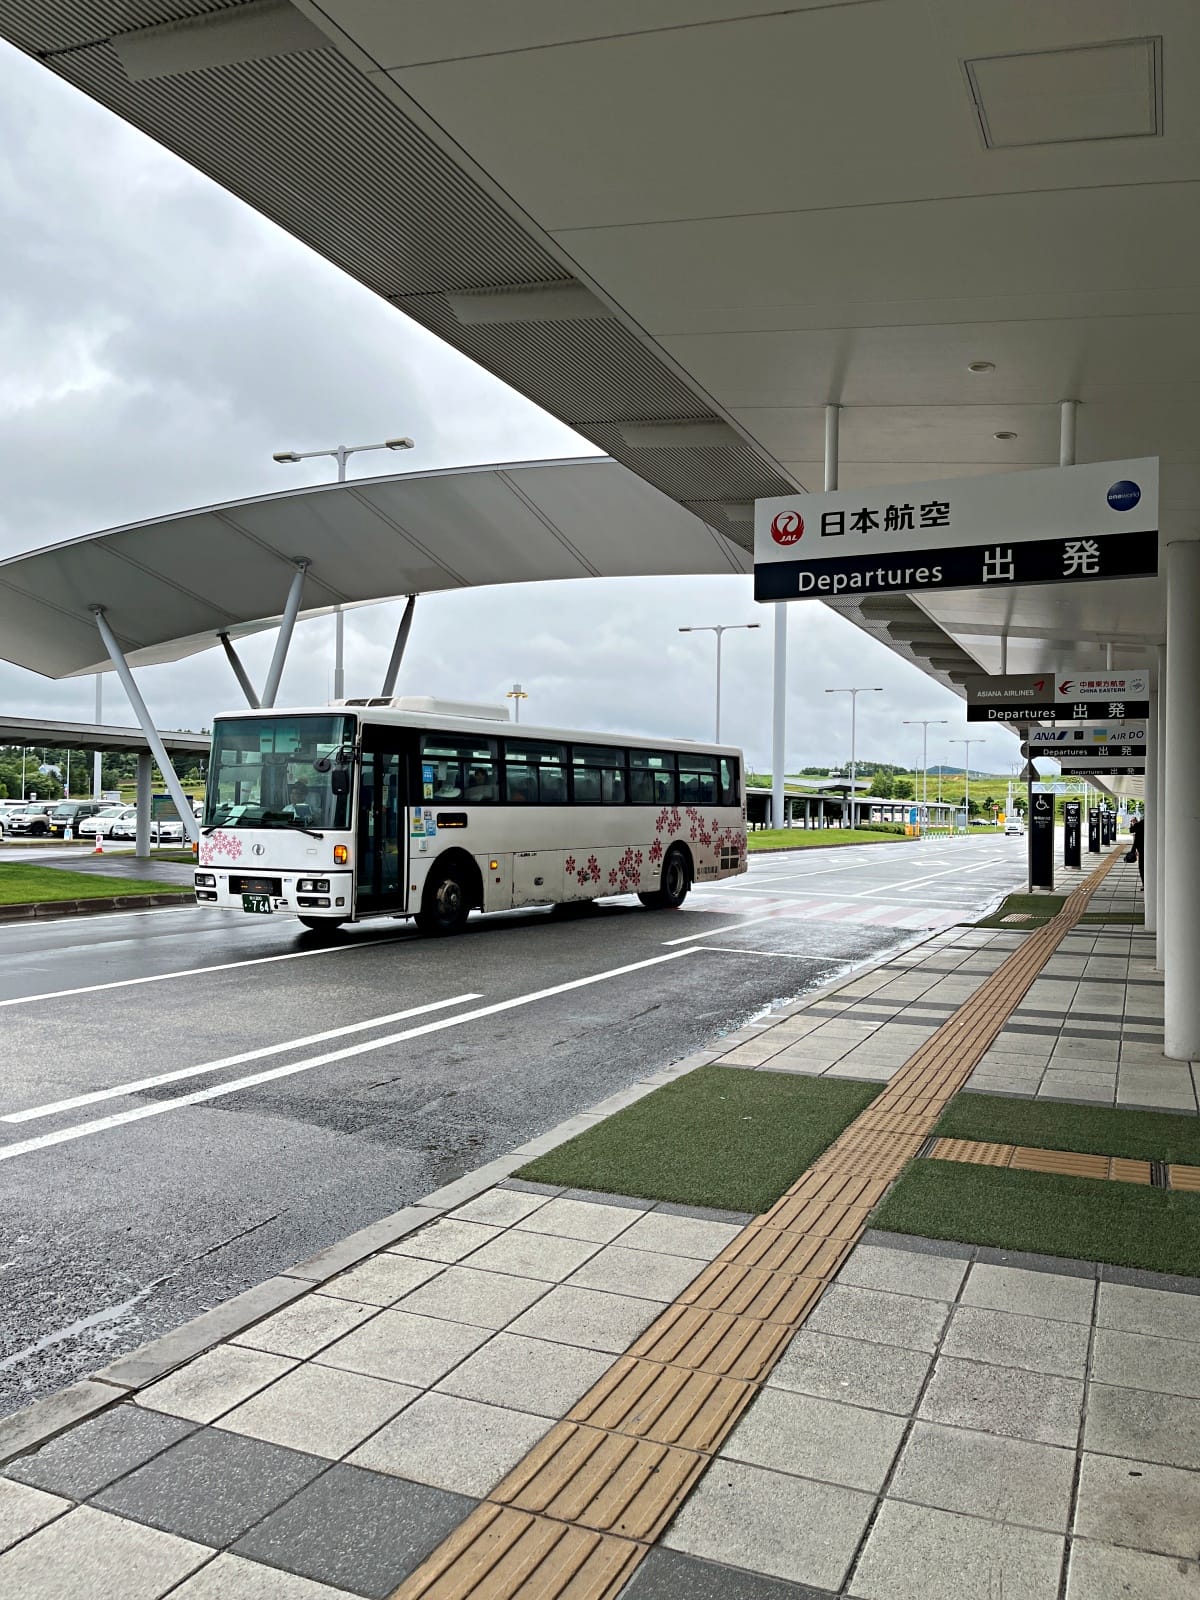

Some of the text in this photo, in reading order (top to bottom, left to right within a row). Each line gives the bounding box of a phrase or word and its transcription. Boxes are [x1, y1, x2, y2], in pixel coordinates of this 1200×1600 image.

[820, 500, 951, 537] 日本航空
[779, 534, 798, 543] JAL
[798, 565, 943, 593] Departures
[977, 689, 1035, 698] ASIANA AIRLINES
[988, 708, 1056, 721] Departures
[1033, 731, 1057, 741] ANA
[1128, 730, 1145, 739] DO
[1043, 748, 1088, 757] Departures
